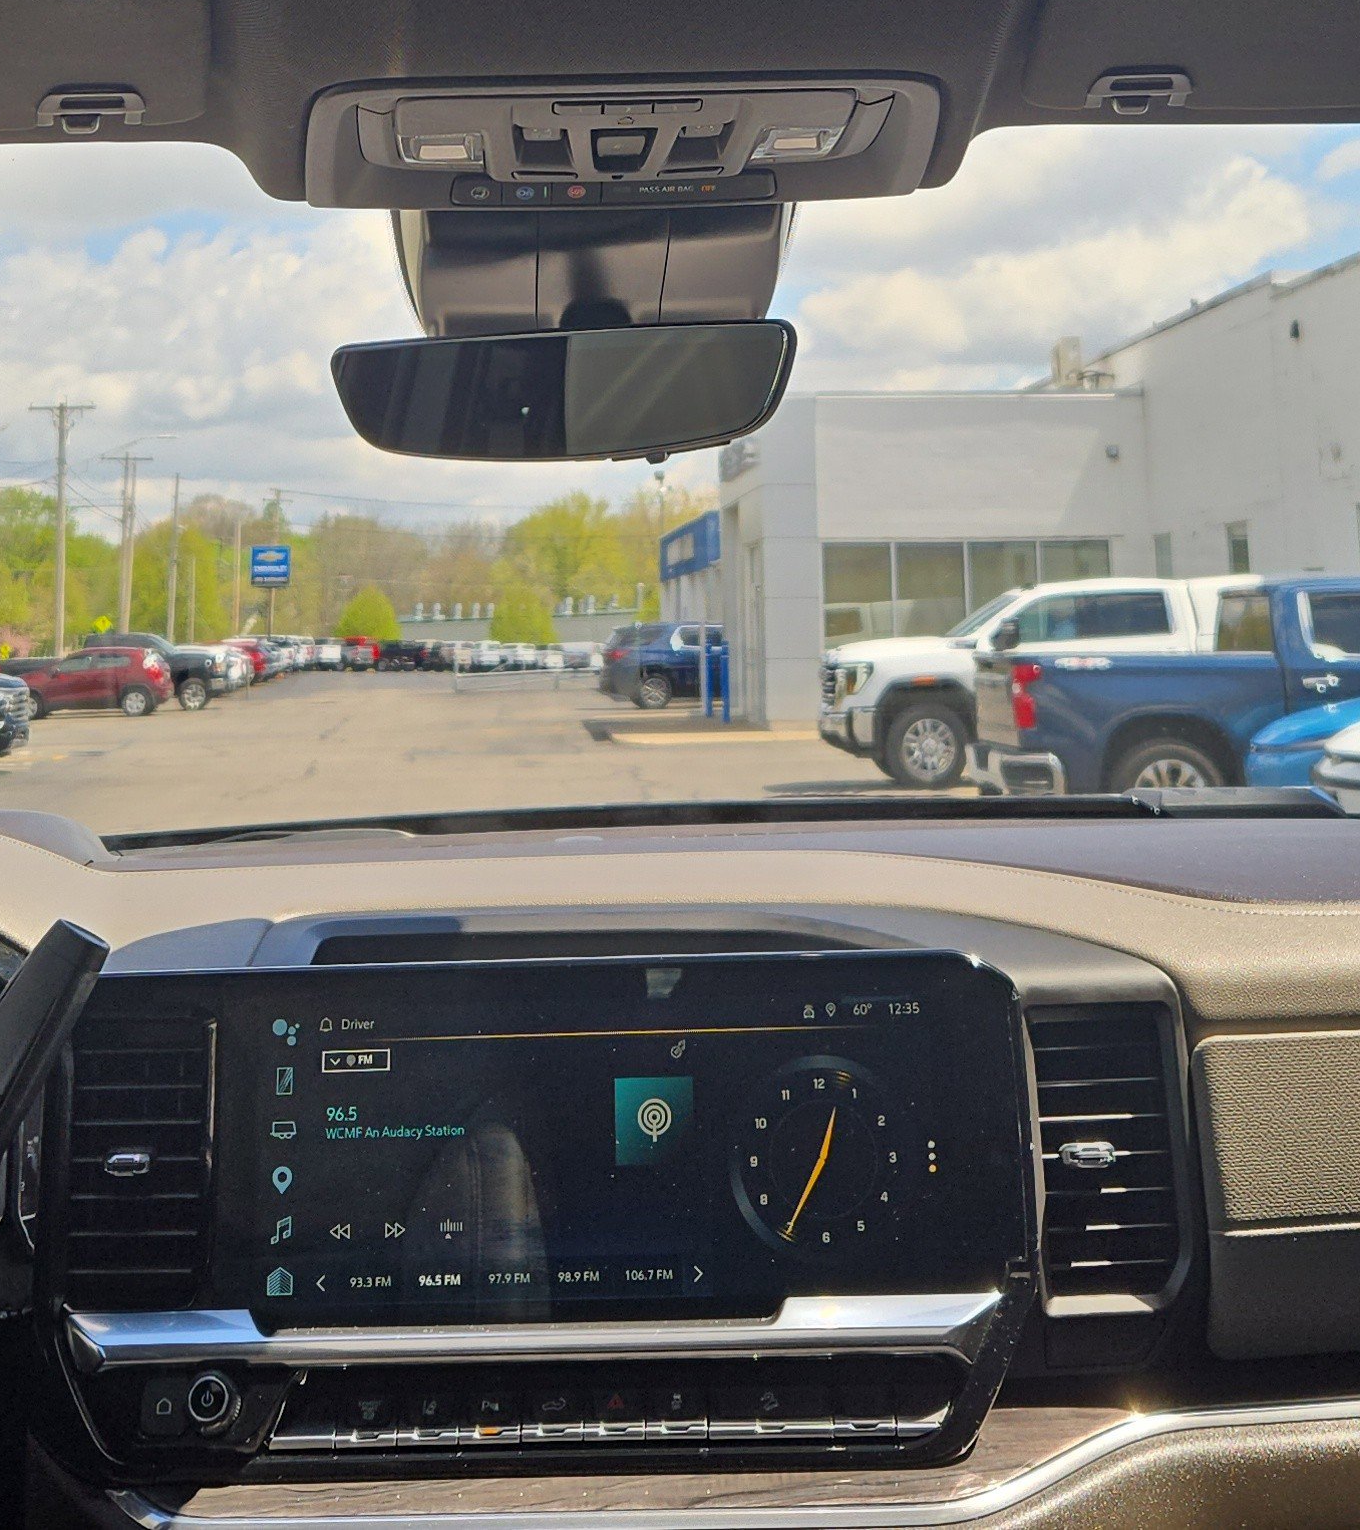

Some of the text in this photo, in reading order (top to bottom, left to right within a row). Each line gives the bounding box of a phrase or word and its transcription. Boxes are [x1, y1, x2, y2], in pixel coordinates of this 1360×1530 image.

[888, 1002, 920, 1015] 12:35
[341, 1019, 375, 1030] Driver
[358, 1054, 373, 1065] FM
[813, 1078, 825, 1089] 12
[781, 1090, 790, 1100] 11
[851, 1088, 857, 1098] 1
[326, 1106, 357, 1121] 96.5
[755, 1118, 767, 1129] 10
[878, 1115, 886, 1126] 2
[325, 1124, 465, 1140] WCMF An Audacy Station
[749, 1156, 758, 1167] 9
[889, 1152, 897, 1163] 3
[759, 1194, 768, 1205] 8
[880, 1191, 889, 1202] 4
[857, 1221, 865, 1231] 5
[822, 1232, 830, 1243] 6
[418, 1273, 461, 1287] 96.5 FM
[488, 1272, 531, 1284] 97.9 FM
[557, 1270, 600, 1283] 98.9 FM
[625, 1269, 673, 1281] 106.7 FM
[350, 1275, 391, 1288] 93.3 FM
